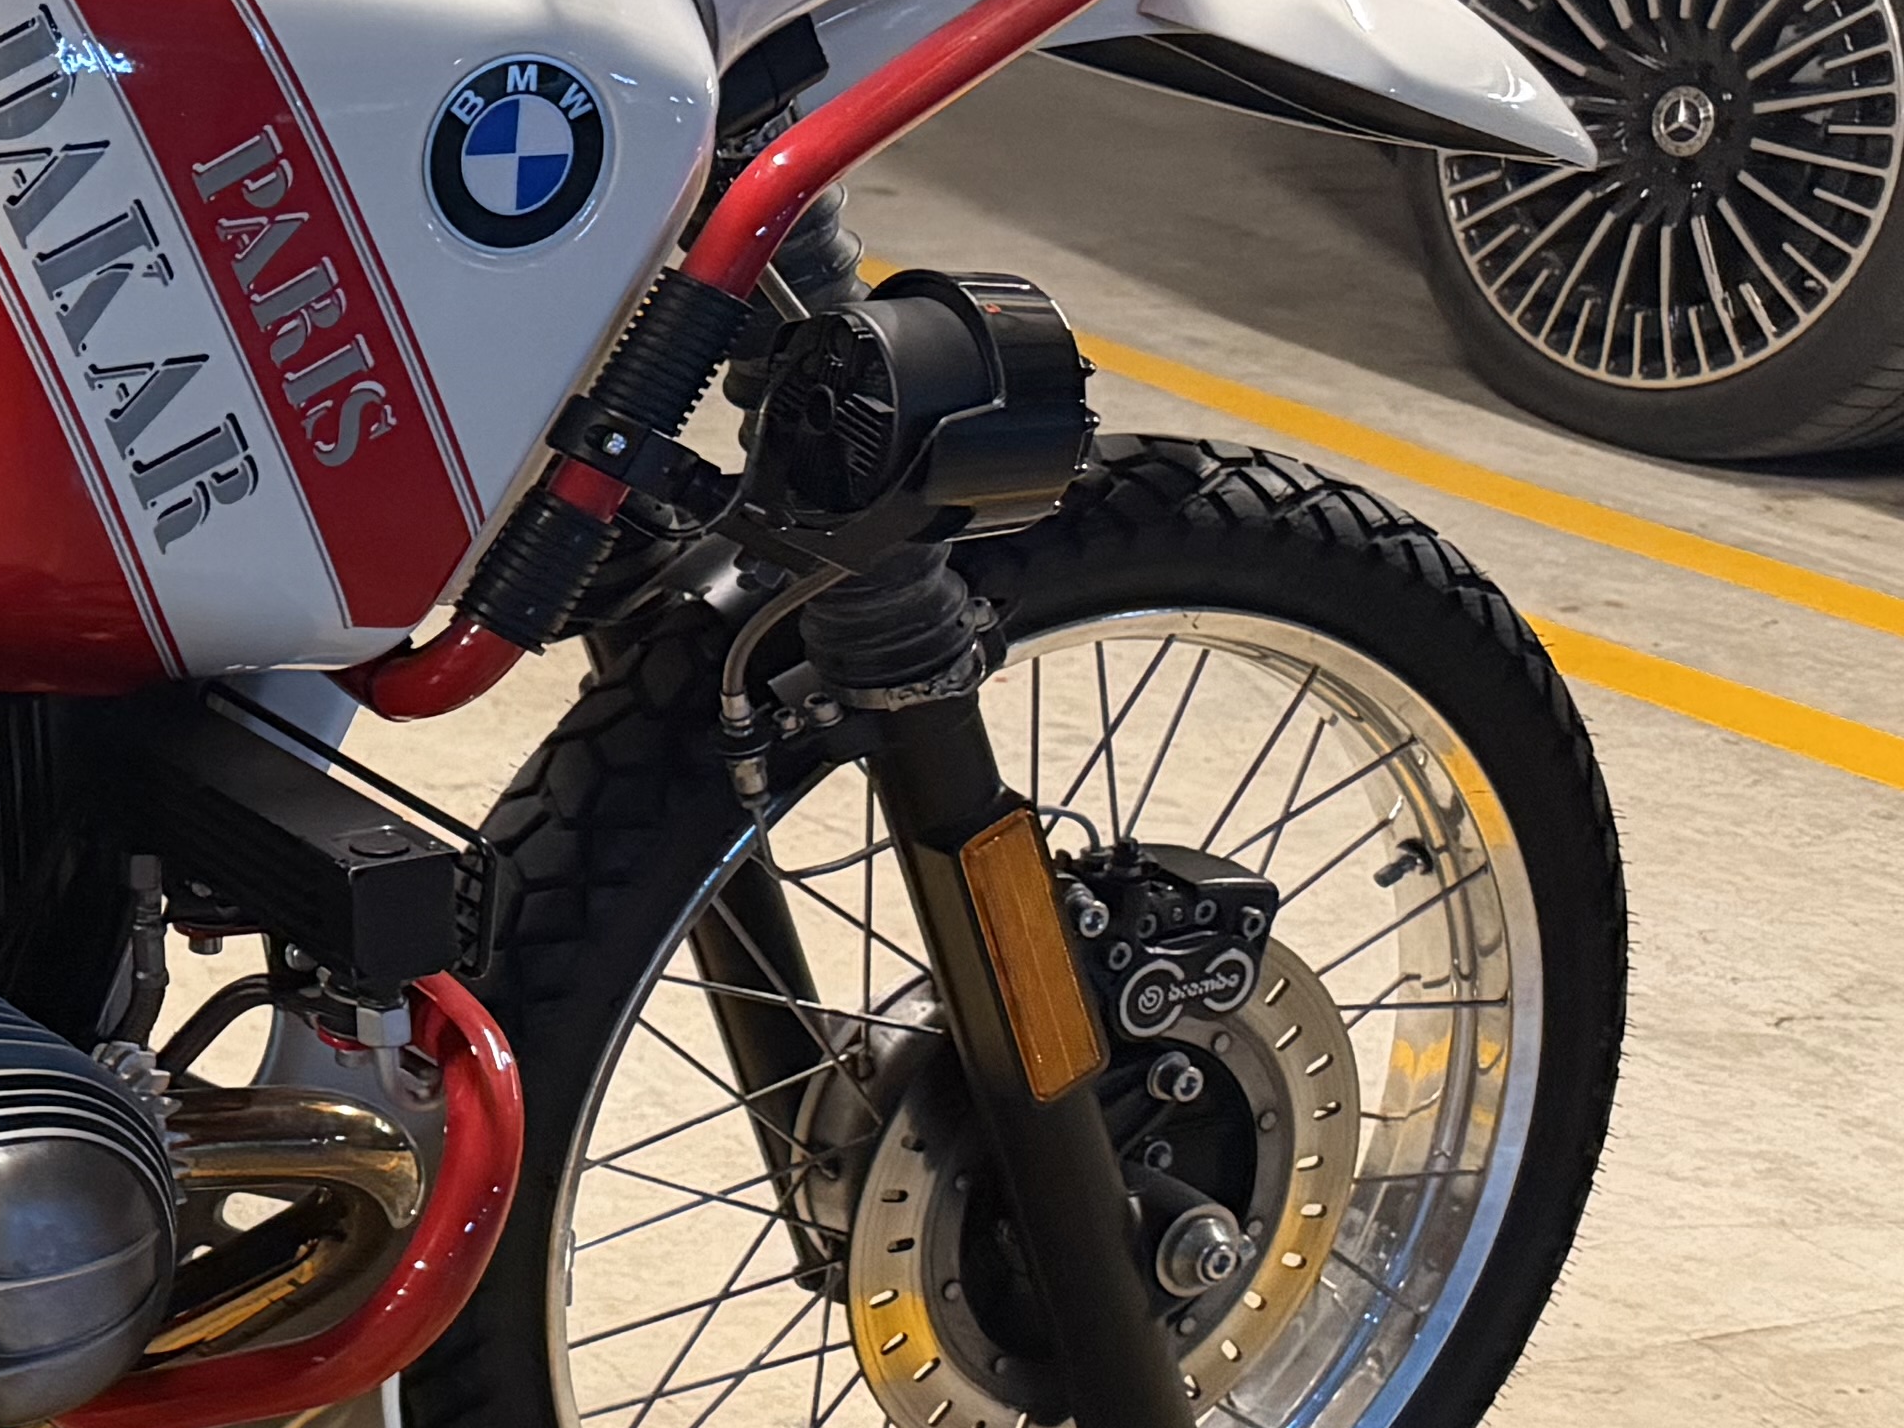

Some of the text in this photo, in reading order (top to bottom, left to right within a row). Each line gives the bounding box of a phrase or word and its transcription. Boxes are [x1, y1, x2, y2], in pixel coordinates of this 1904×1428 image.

[451, 62, 595, 124] BMW
[191, 124, 397, 468] PARIS
[1168, 971, 1240, 1002] brembo
